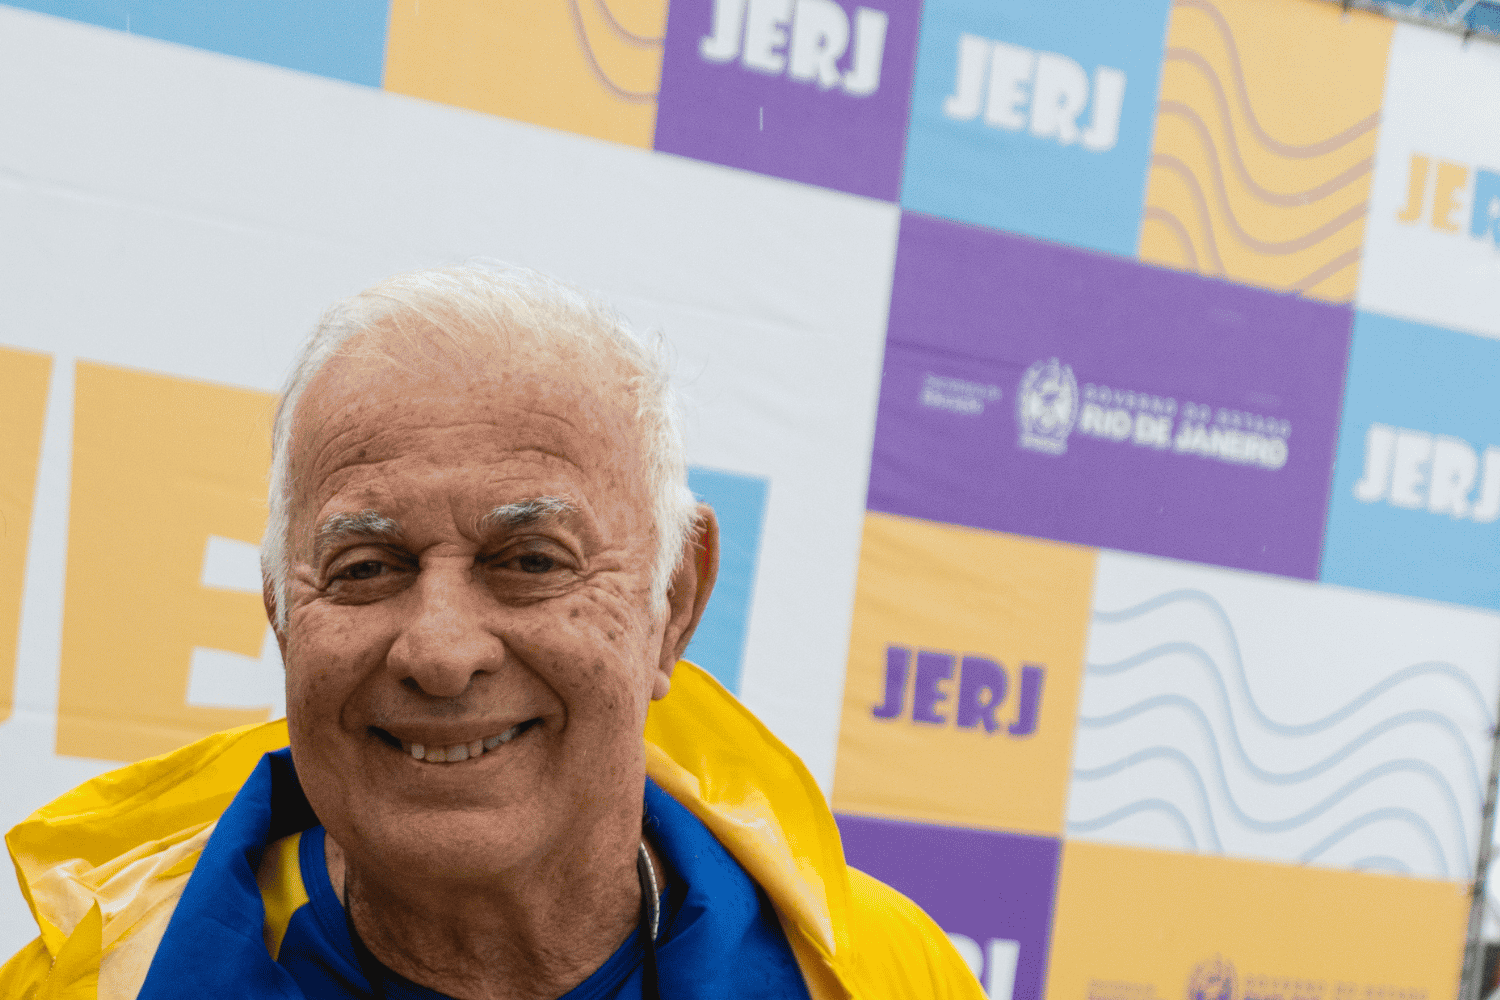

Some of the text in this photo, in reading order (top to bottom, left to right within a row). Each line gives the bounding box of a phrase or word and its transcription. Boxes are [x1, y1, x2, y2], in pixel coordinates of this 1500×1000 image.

[700, 0, 888, 97] JERJ
[942, 32, 1127, 152] JERJ
[1397, 152, 1500, 256] JER
[1079, 403, 1132, 443] RIO
[1133, 414, 1172, 450] DE
[1353, 422, 1500, 523] JERJ
[872, 643, 1047, 738] JERJ
